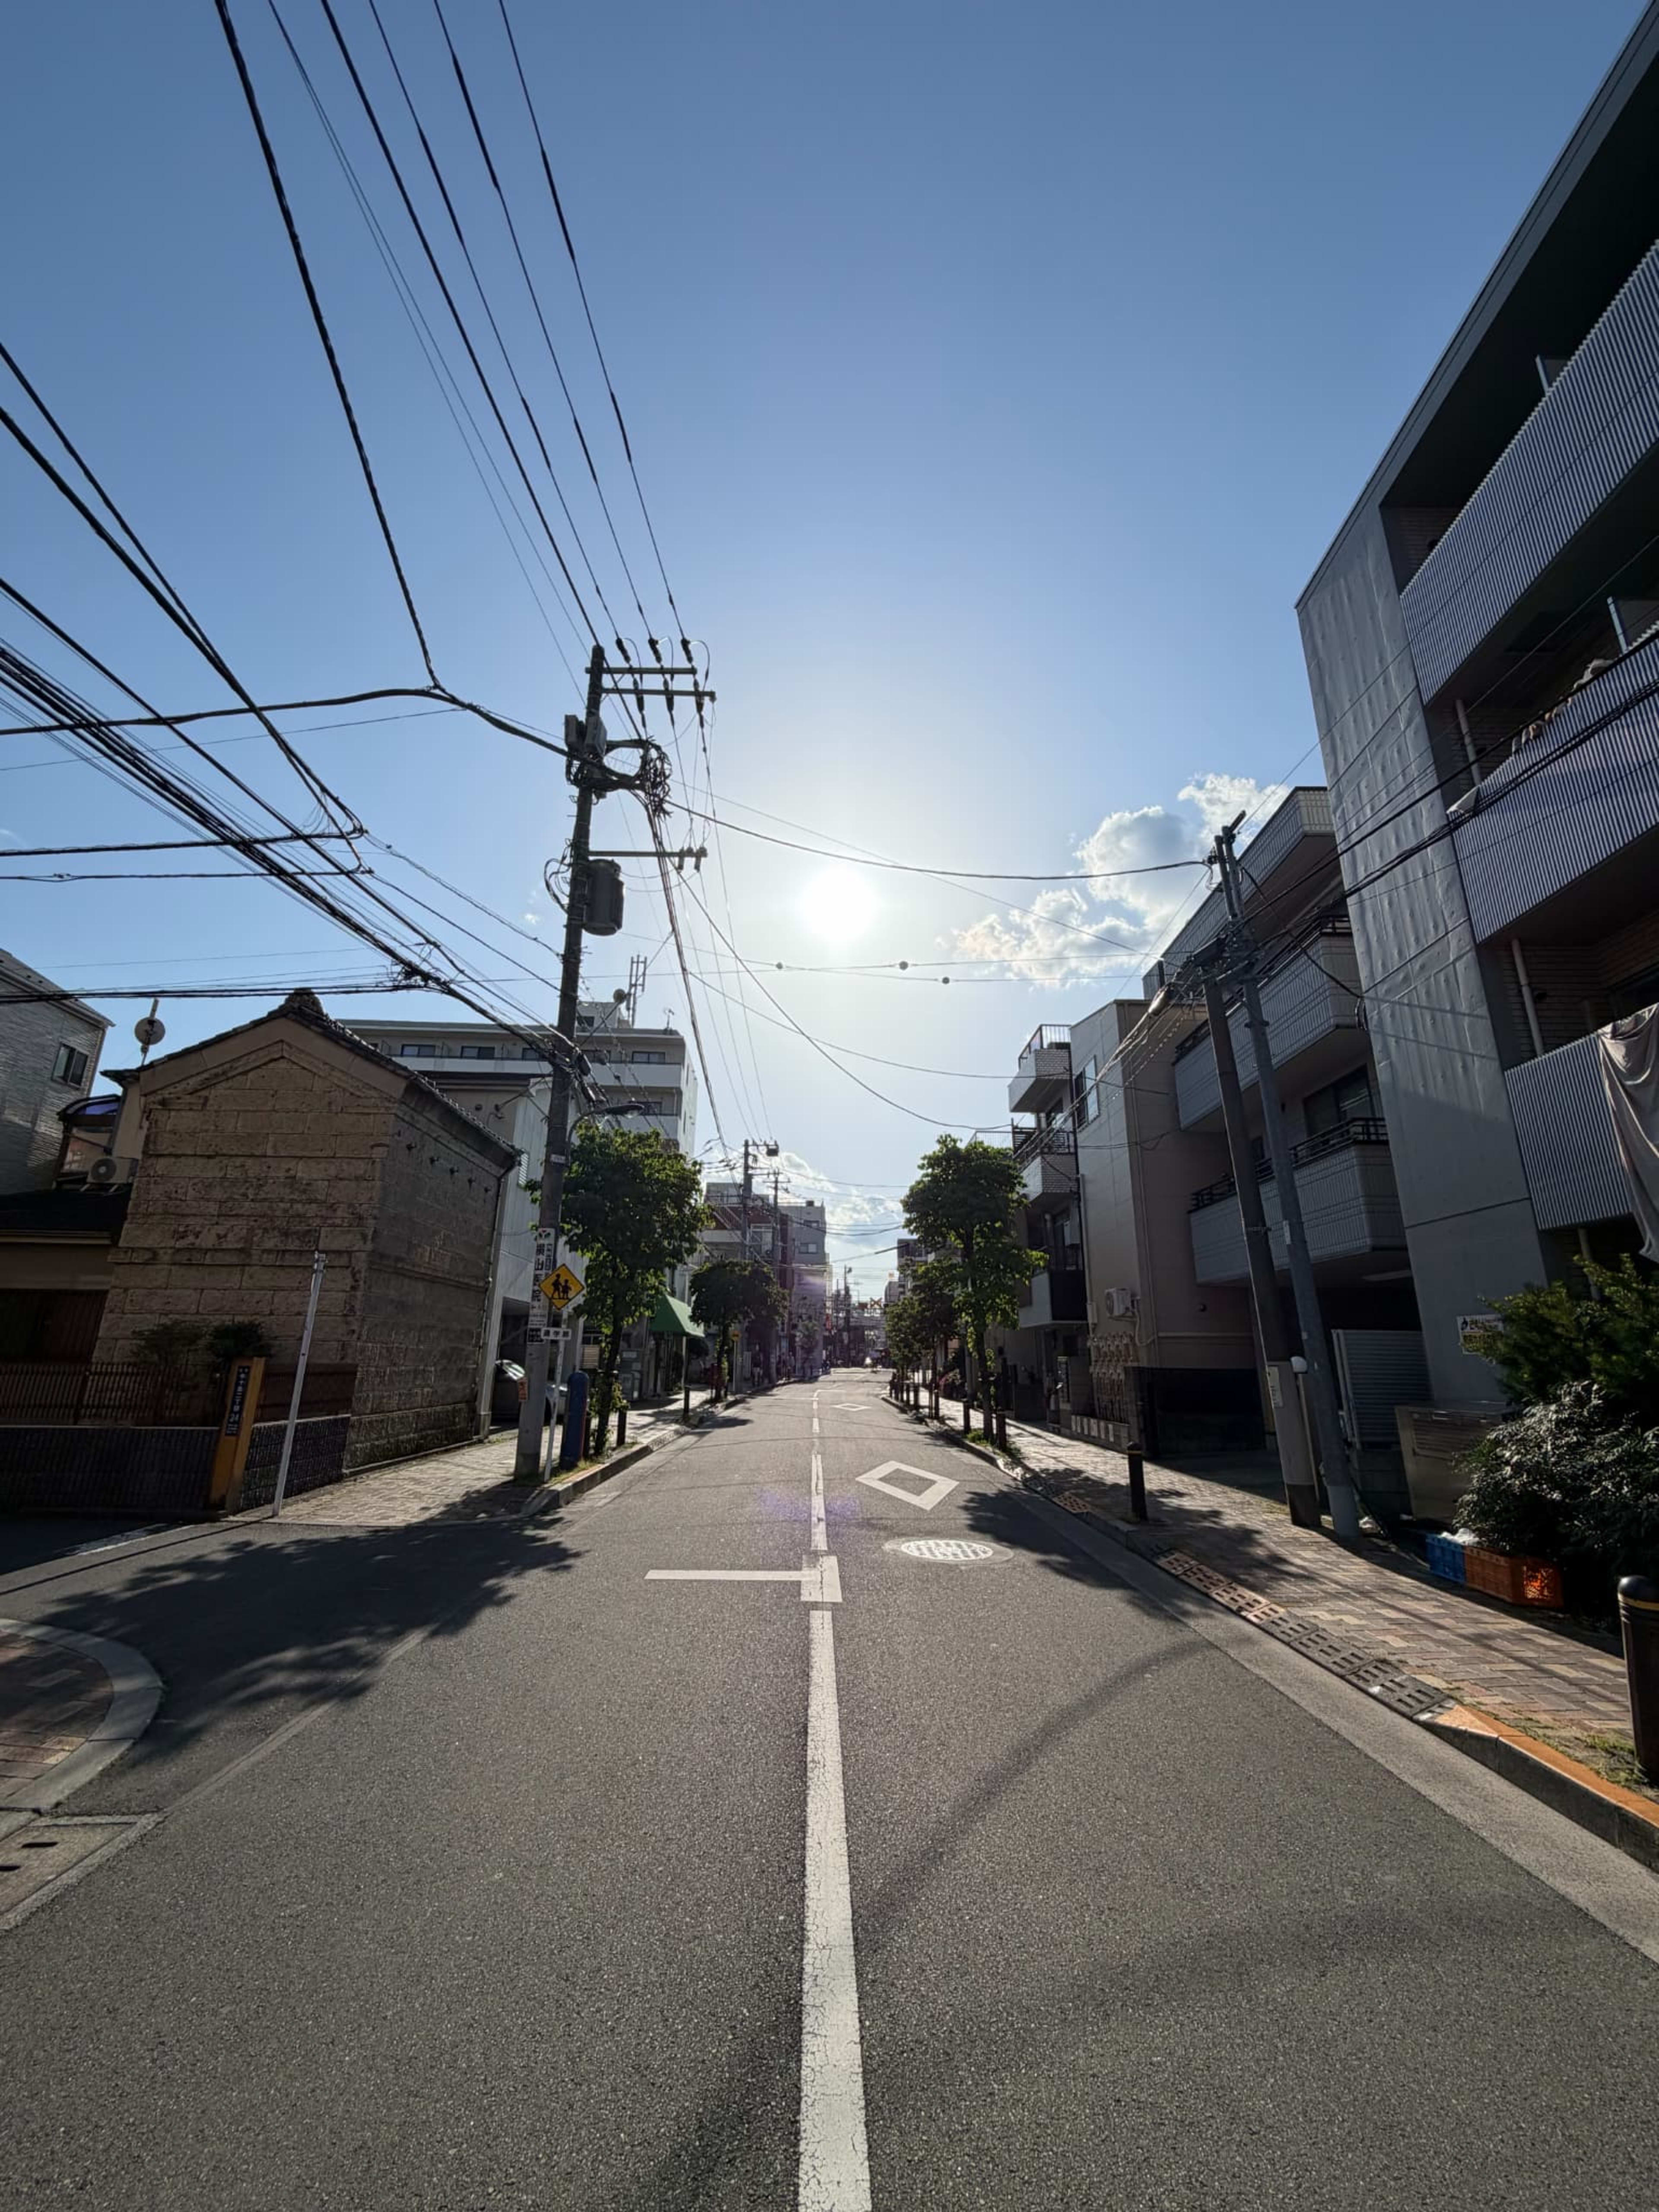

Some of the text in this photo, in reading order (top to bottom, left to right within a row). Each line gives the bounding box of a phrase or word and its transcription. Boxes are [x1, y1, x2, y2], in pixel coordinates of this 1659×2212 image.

[531, 1244, 545, 1302] 横山医院
[543, 1329, 569, 1338] 通学路
